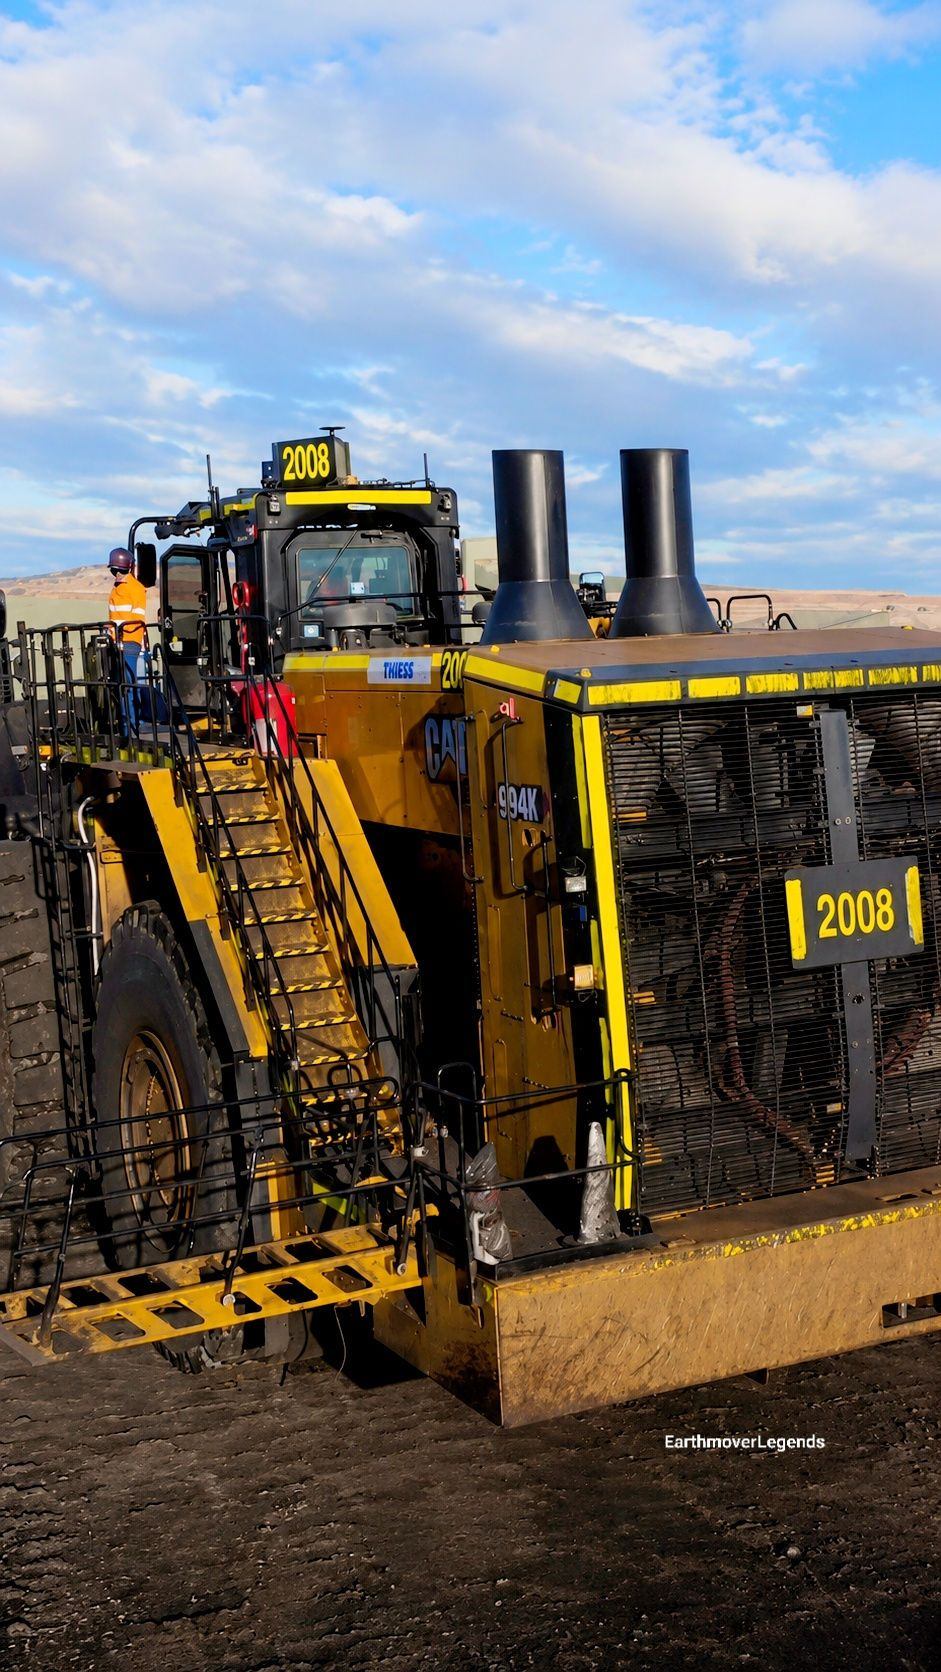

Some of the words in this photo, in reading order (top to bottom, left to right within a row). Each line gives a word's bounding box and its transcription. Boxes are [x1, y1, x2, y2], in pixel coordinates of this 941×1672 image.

[282, 443, 330, 480] 2008
[384, 662, 414, 679] THIESS
[499, 785, 539, 821] 994K
[817, 888, 895, 938] 2008
